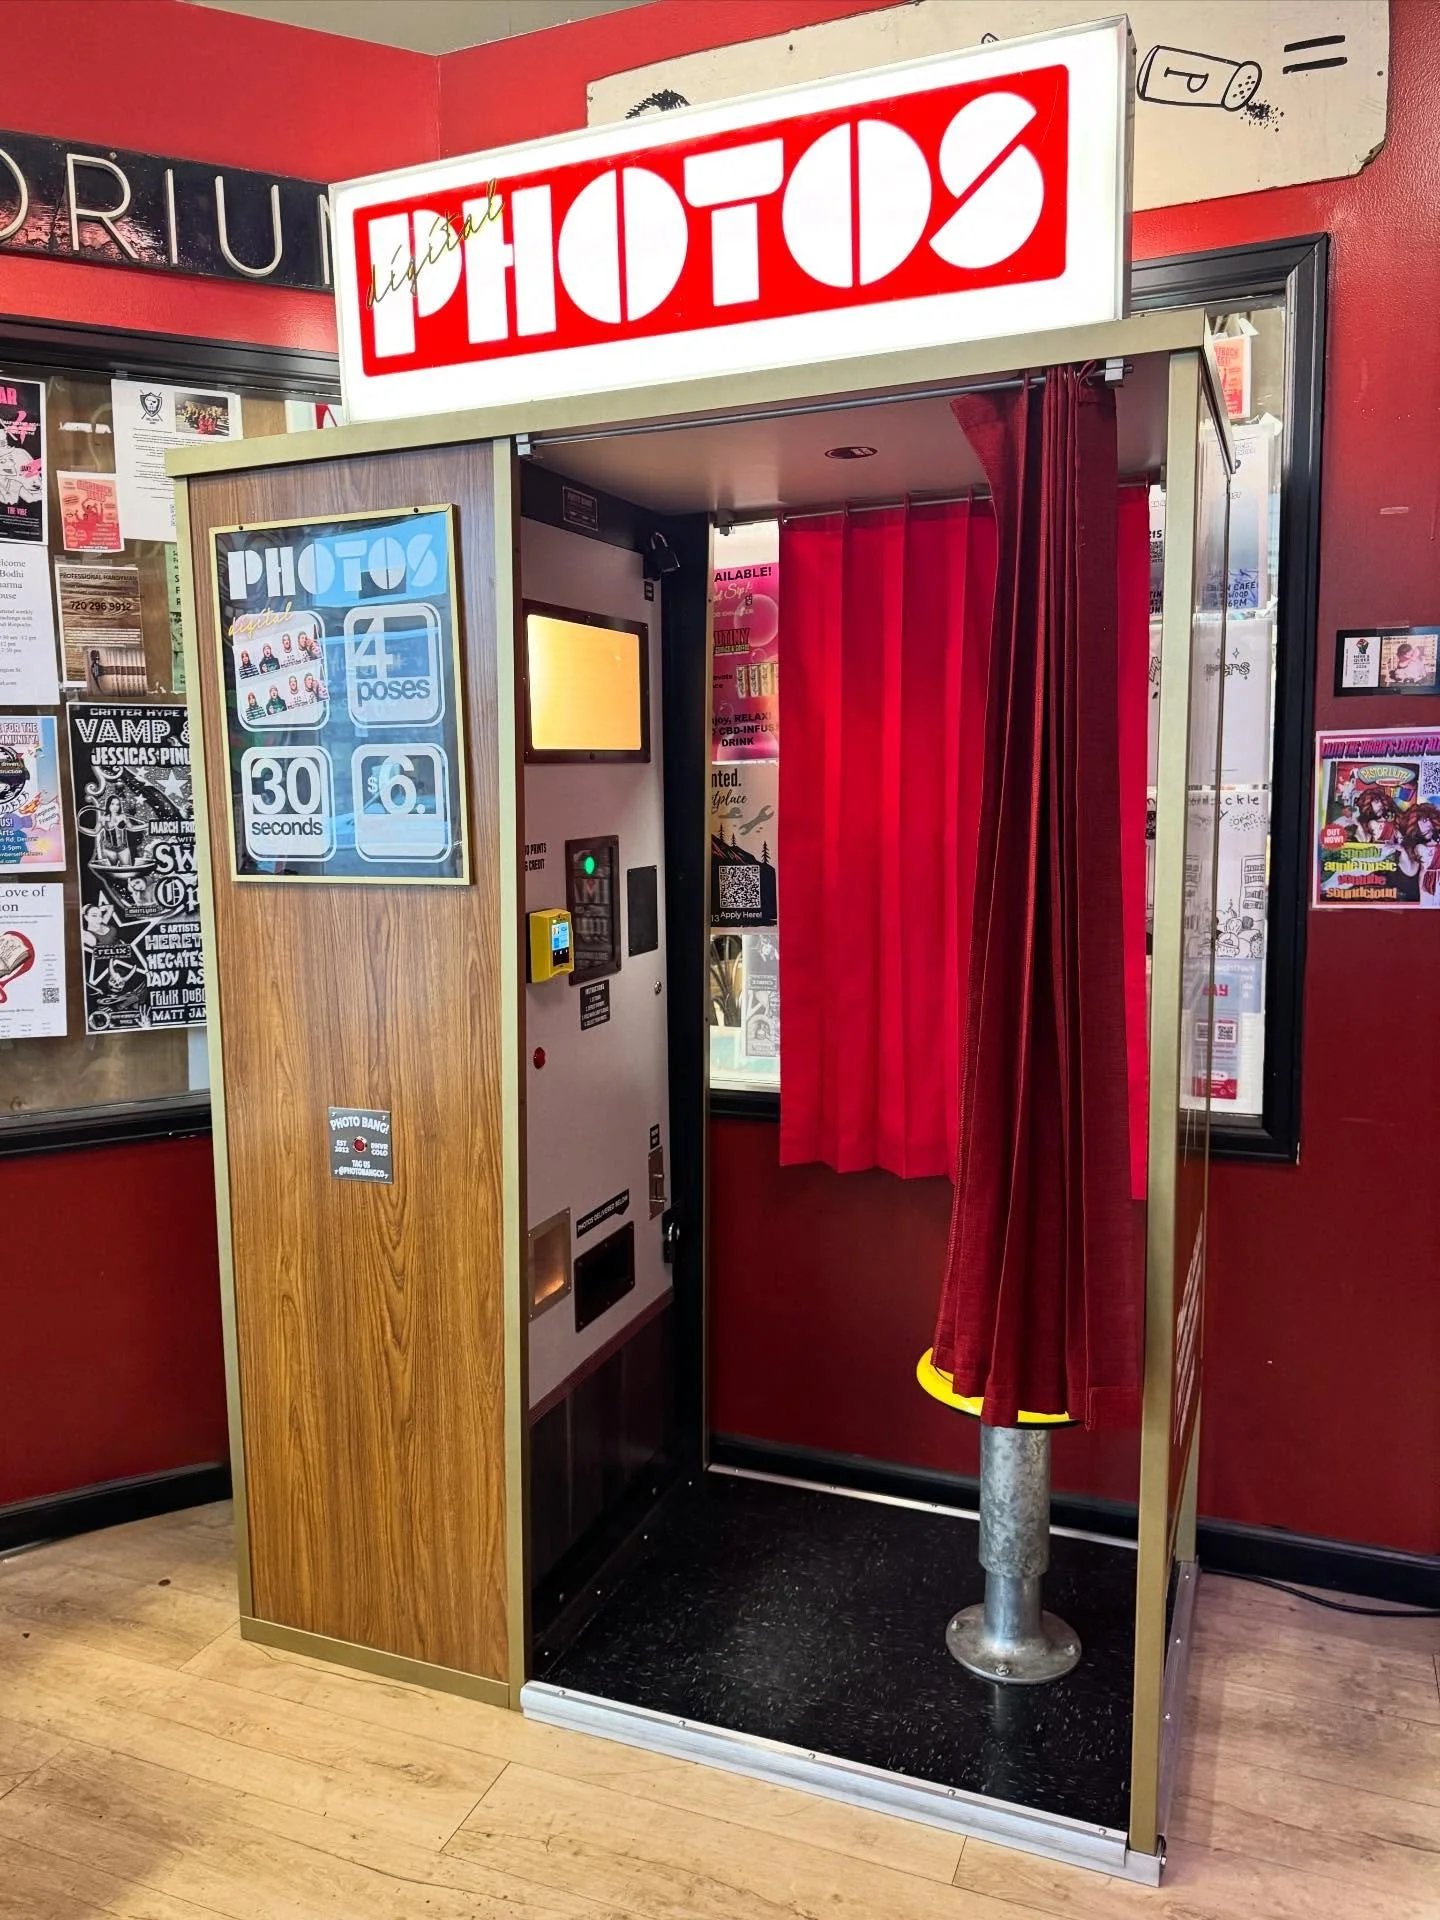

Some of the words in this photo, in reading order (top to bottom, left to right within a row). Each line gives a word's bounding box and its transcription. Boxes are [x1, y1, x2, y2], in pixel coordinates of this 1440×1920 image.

[368, 91, 1045, 358] PHOTOS
[367, 178, 505, 311] digital
[227, 533, 438, 601] PHOTOS
[60, 572, 102, 580] PROFESSIONAL
[70, 600, 87, 610] 720
[89, 602, 107, 611] 296
[109, 602, 132, 612] 9912
[227, 601, 293, 638] digital
[356, 678, 431, 709] poses
[90, 708, 142, 717] CRITTER
[146, 709, 180, 717] HYPE
[4, 722, 20, 733] FOR
[21, 722, 38, 733] THE
[75, 718, 171, 744] VAMP
[721, 737, 754, 747] DRINK
[250, 756, 322, 816] 30
[1, 818, 13, 827] US!
[150, 820, 178, 834] MARCH
[251, 816, 323, 838] seconds
[1326, 828, 1341, 836] OUT
[1324, 835, 1344, 844] NOW!
[1359, 860, 1397, 871] music
[32, 885, 47, 898] of
[1326, 887, 1397, 899] soundcloud
[720, 911, 742, 920] Apply
[168, 923, 200, 933] ARTISTS
[152, 1009, 185, 1021] MATT
[330, 1116, 361, 1131] PHOTO
[361, 1117, 390, 1135] BANG!
[351, 1160, 362, 1168] TAG
